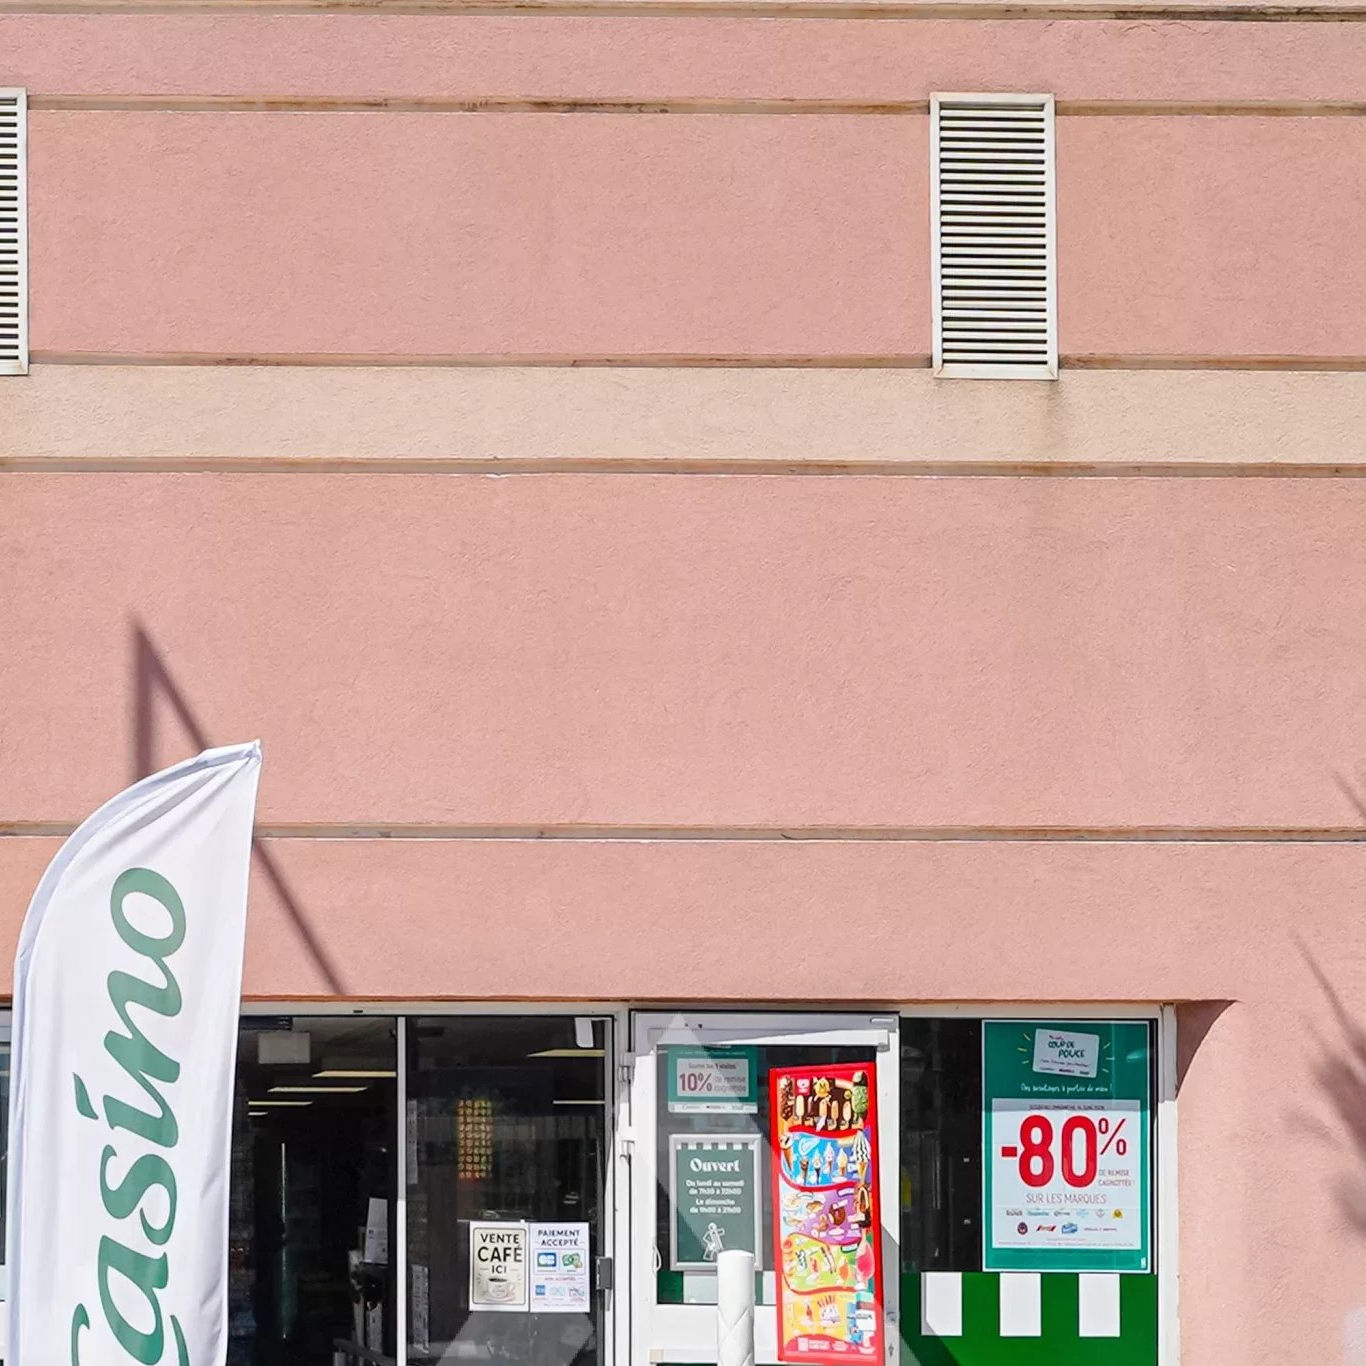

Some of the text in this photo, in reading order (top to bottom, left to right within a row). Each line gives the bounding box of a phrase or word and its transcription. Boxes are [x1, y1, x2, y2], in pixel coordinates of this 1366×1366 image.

[679, 1072, 713, 1092] 10%
[1001, 1114, 1128, 1188] -80%
[690, 1158, 740, 1172] Ouvert
[480, 1233, 520, 1245] VENTE
[538, 1229, 580, 1237] PAIEMENT
[541, 1238, 579, 1247] ACCEPTÉ
[477, 1244, 523, 1262] CAFÉ
[491, 1265, 507, 1274] ICI
